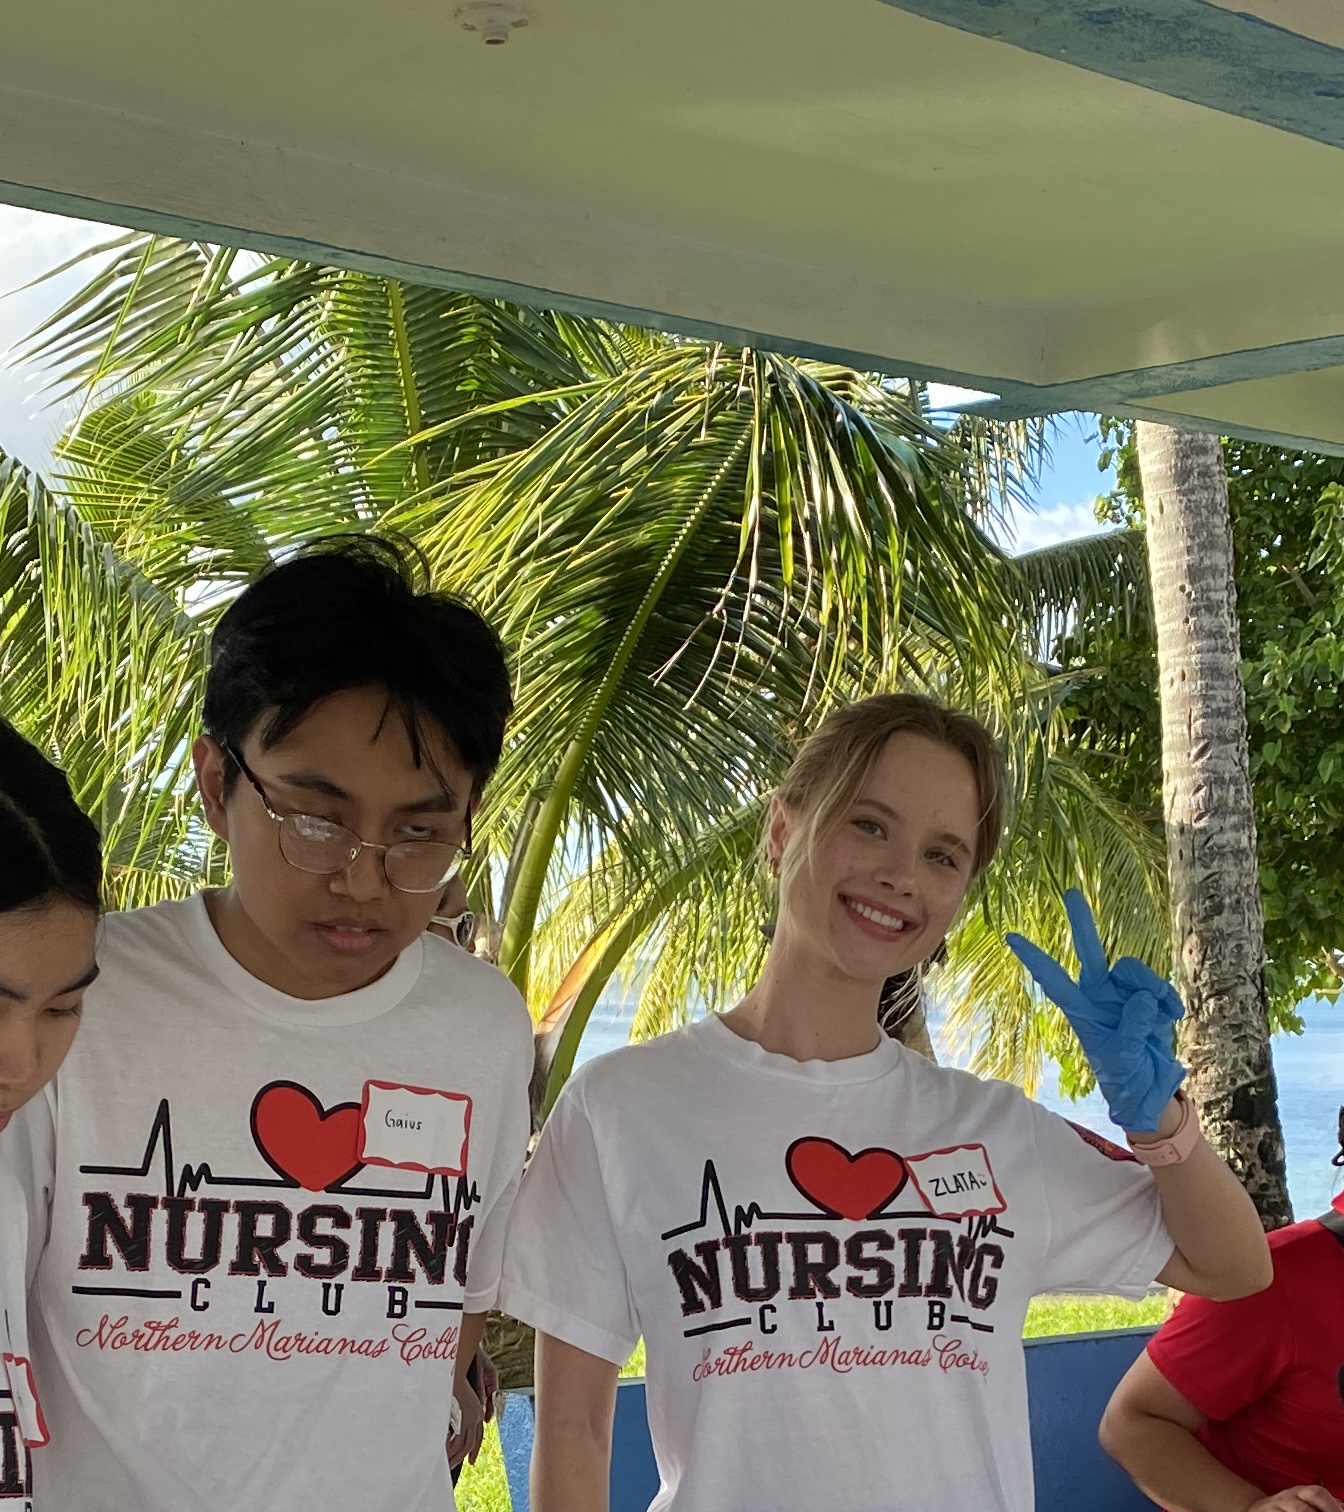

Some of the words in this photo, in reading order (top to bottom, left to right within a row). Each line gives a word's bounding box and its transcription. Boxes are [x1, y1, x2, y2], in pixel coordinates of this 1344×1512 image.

[385, 1109, 423, 1131] Gaius
[928, 1171, 981, 1197] ZLATA
[667, 1227, 1005, 1316] NURSING
[190, 1277, 408, 1319] CLUB
[759, 1300, 946, 1335] CLUB
[76, 1314, 229, 1353] Northern
[230, 1318, 391, 1361] Marianas
[799, 1335, 931, 1373] Marianas
